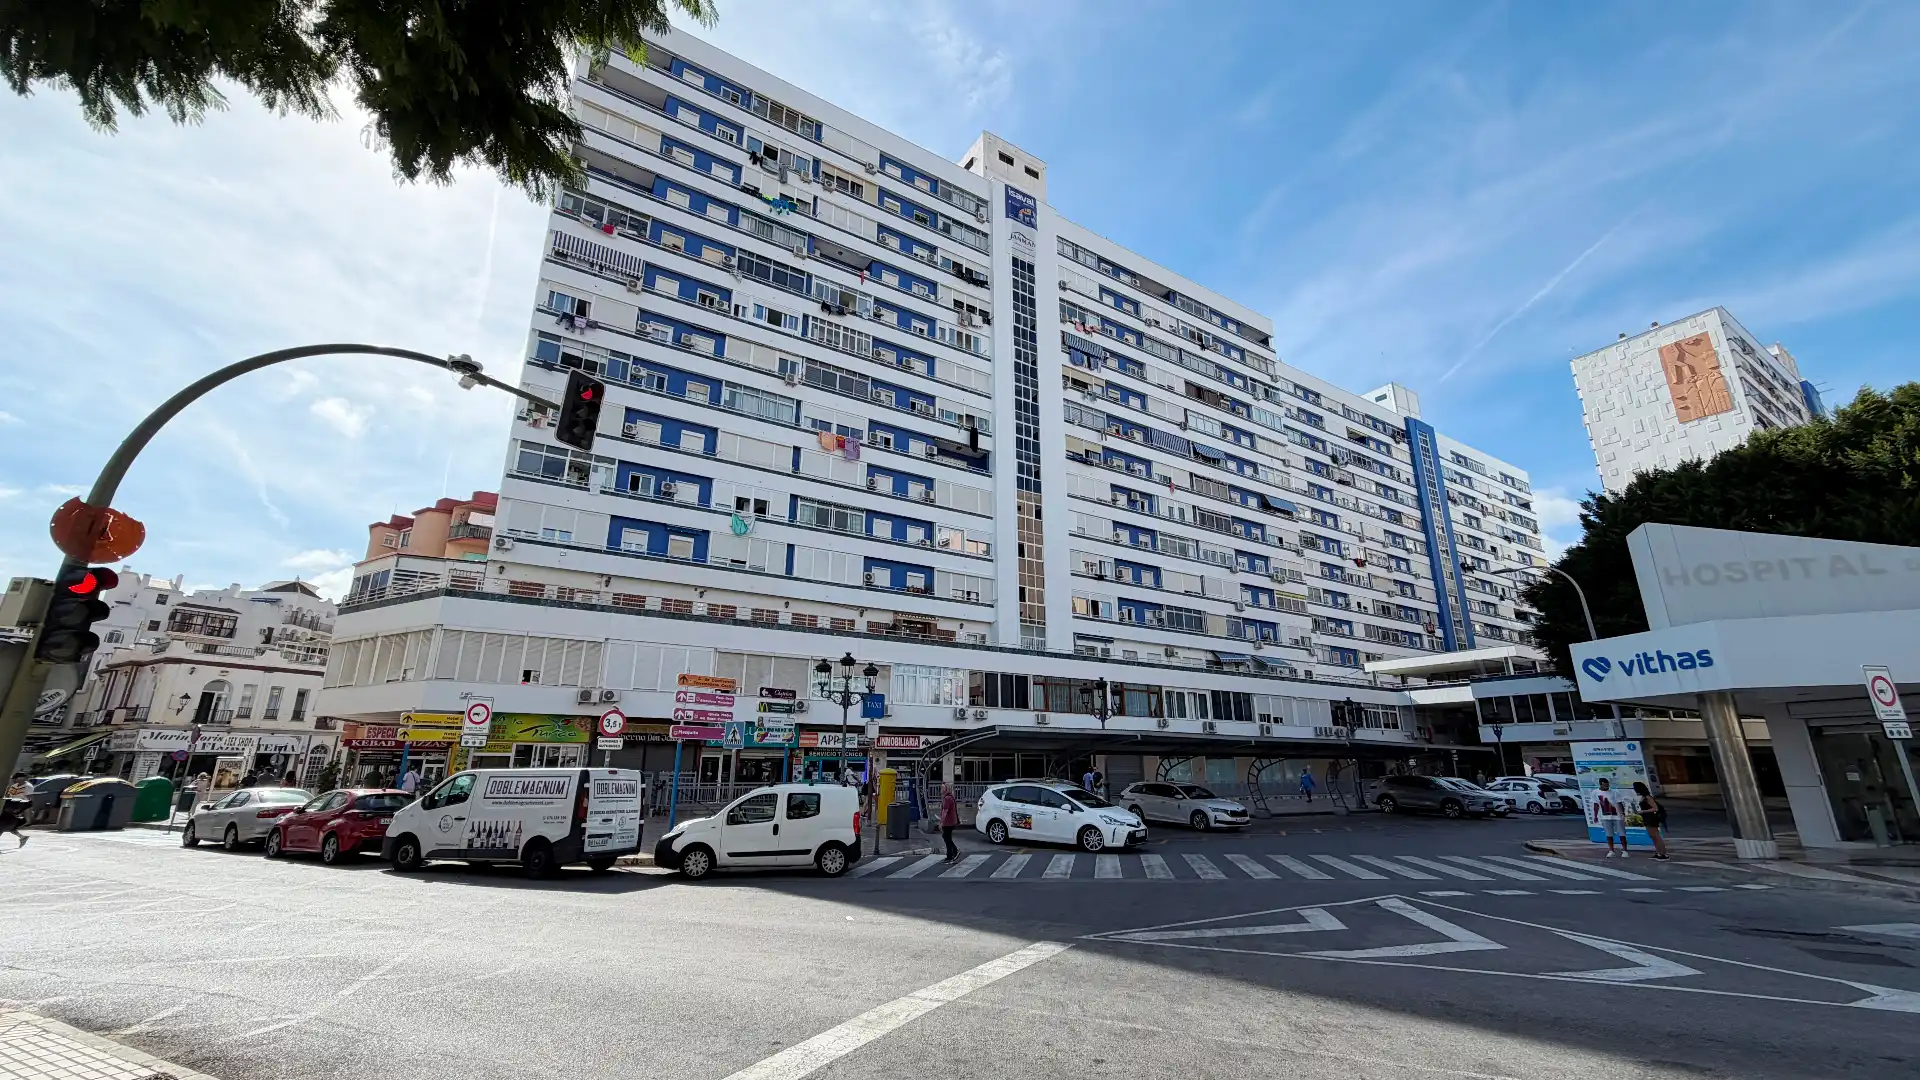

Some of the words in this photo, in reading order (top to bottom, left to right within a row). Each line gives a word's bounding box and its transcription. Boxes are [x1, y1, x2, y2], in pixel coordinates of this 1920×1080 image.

[1663, 554, 1889, 587] HOSPITAL
[1618, 647, 1714, 677] vithas
[605, 719, 617, 730] 3,5
[351, 739, 396, 748] KEBAB
[406, 740, 448, 748] PIZZAS
[489, 780, 567, 795] DOBLEMAGNUM
